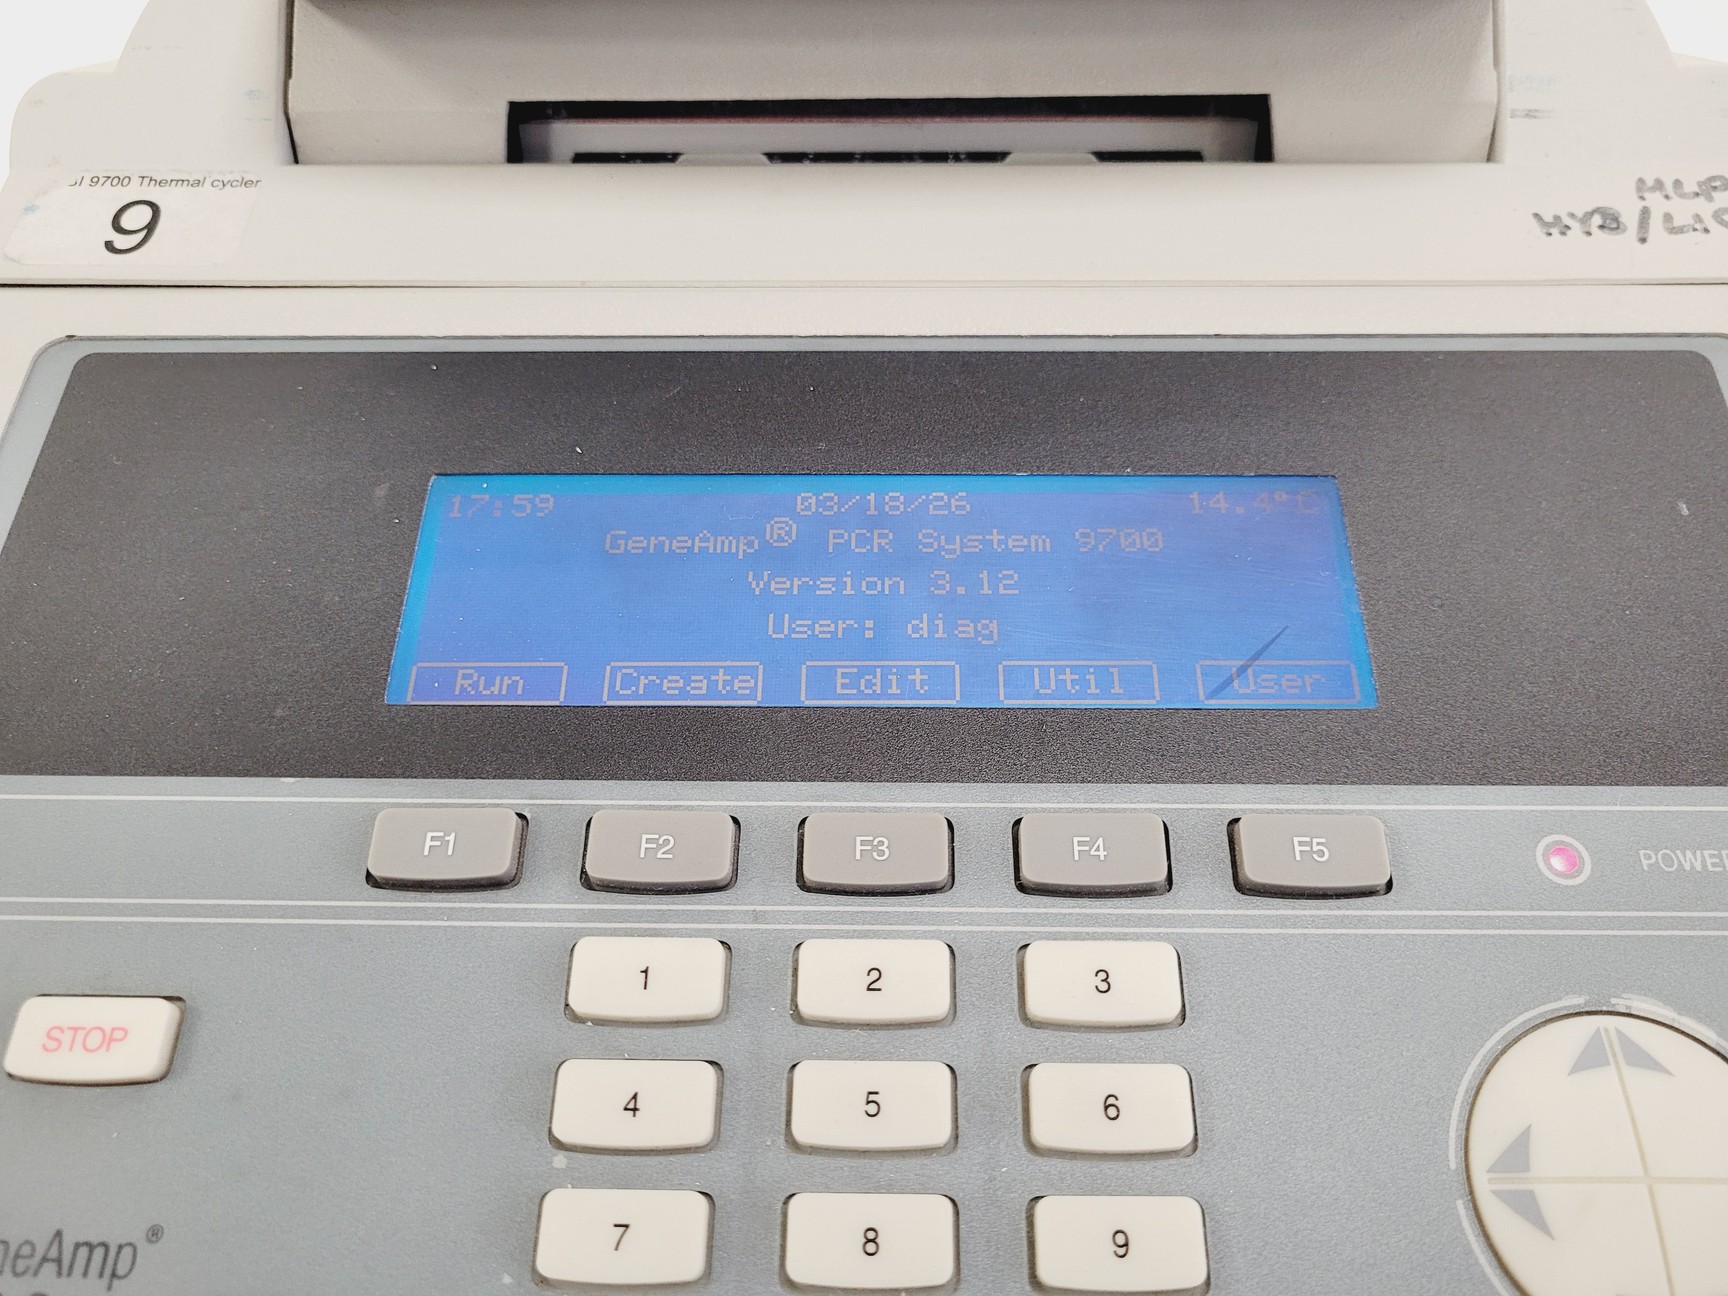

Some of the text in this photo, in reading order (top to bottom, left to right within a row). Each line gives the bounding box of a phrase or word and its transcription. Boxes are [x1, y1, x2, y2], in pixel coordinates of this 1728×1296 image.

[88, 175, 131, 188] 9700
[137, 175, 206, 188] Thermal
[210, 176, 261, 190] cycler
[104, 199, 161, 255] 9
[446, 493, 555, 517] 17:59
[796, 491, 971, 516] 03/18/26
[827, 529, 894, 553] PCR
[917, 529, 1051, 559] System
[1074, 528, 1164, 553] 9700
[747, 570, 1020, 595] Version 3.12
[767, 613, 998, 645] User: diag
[454, 668, 525, 695] Run
[614, 668, 756, 695] Create
[835, 668, 930, 695] Edit
[1033, 667, 1125, 694] Util
[1232, 667, 1327, 694] User
[422, 831, 456, 857] F1
[638, 834, 675, 859] F2
[854, 836, 890, 861] F3
[1072, 836, 1108, 861] F4
[1292, 836, 1330, 863] F5
[639, 966, 650, 991] 1
[866, 967, 882, 992] 2
[1094, 968, 1112, 994] 3
[41, 1025, 129, 1053] STOP
[622, 1091, 641, 1118] 4
[864, 1090, 881, 1118] 5
[1103, 1093, 1121, 1121] 6
[613, 1223, 631, 1251] 7
[862, 1226, 880, 1257] 8
[1111, 1229, 1130, 1259] 9
